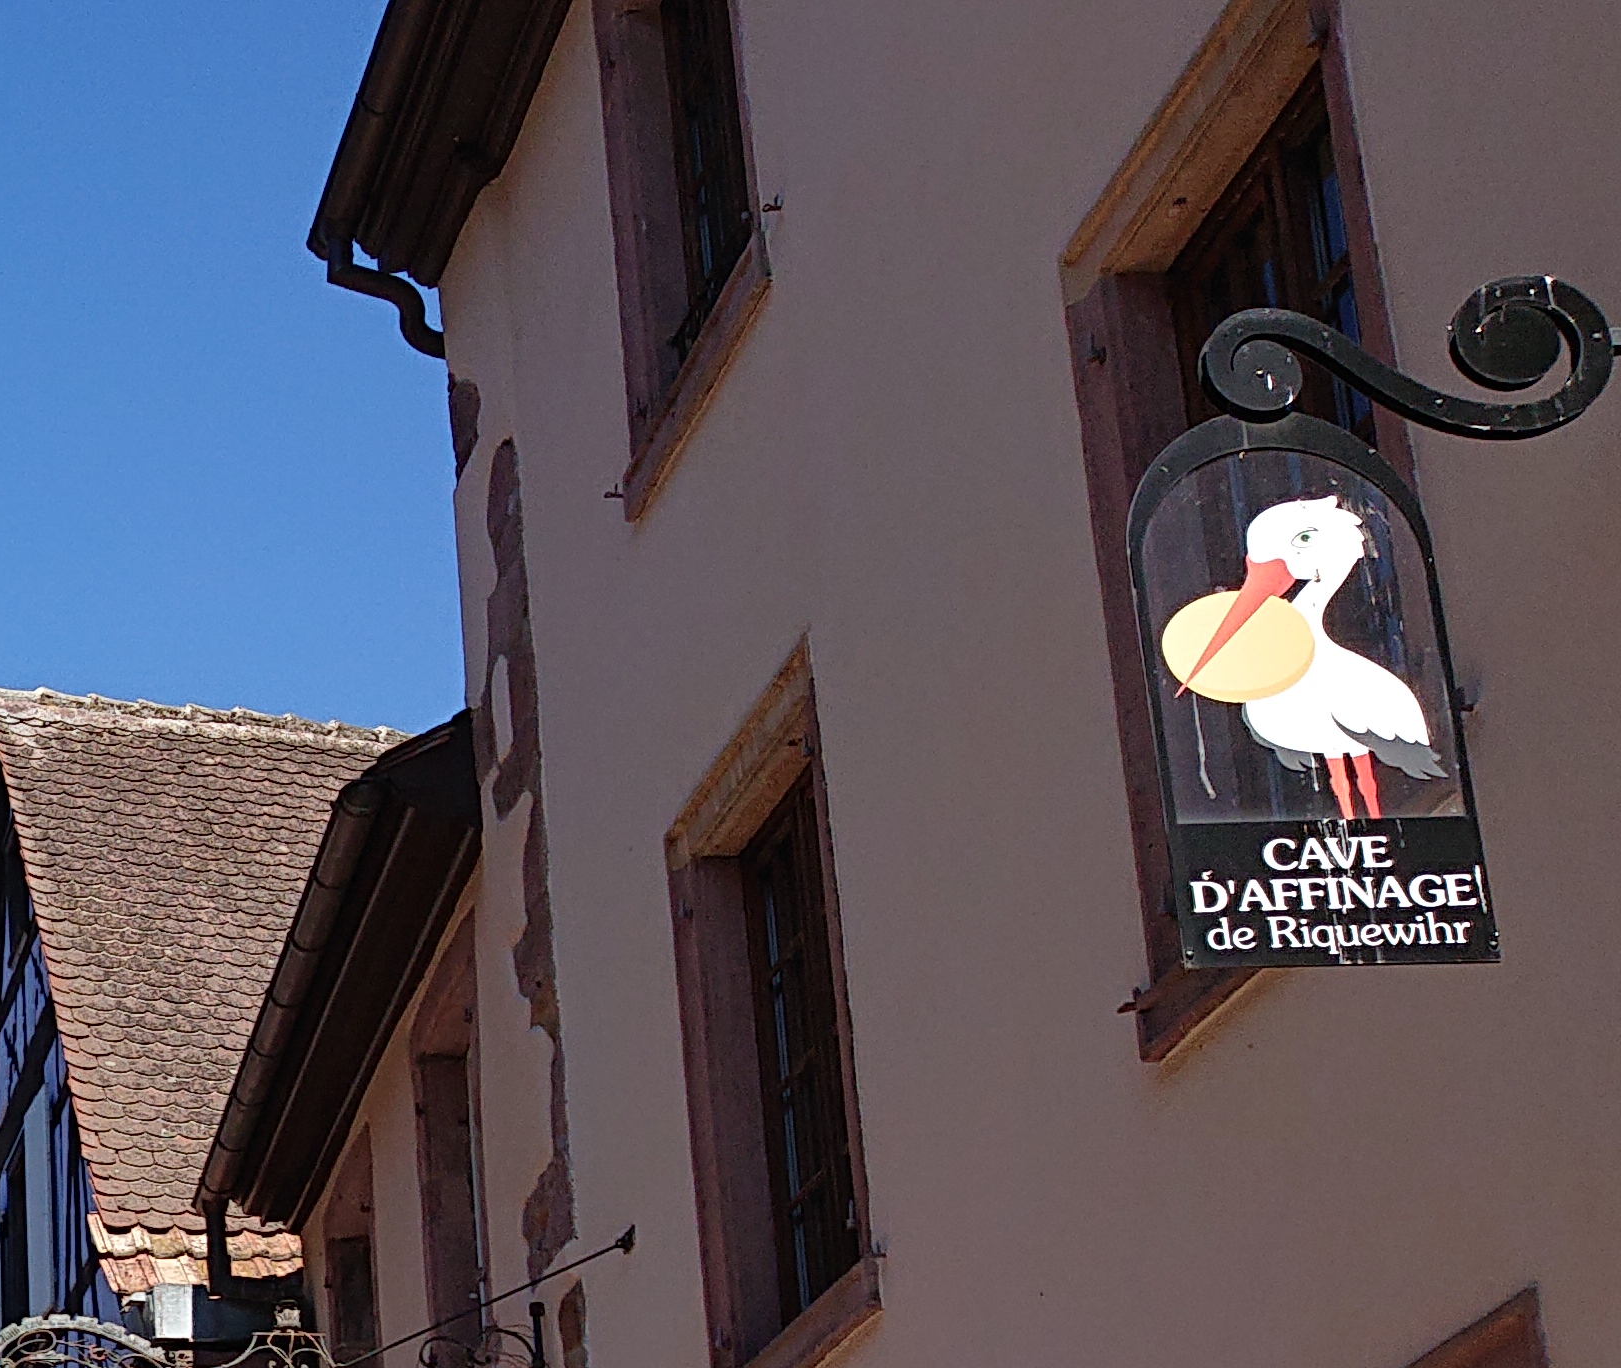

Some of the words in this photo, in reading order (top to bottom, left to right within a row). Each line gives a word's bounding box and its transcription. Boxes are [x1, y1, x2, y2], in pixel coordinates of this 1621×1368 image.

[1262, 835, 1395, 871] CAVE
[1190, 873, 1478, 914] D'AFFINAGE
[1207, 916, 1257, 951] de
[1265, 911, 1471, 955] Riquewihr
